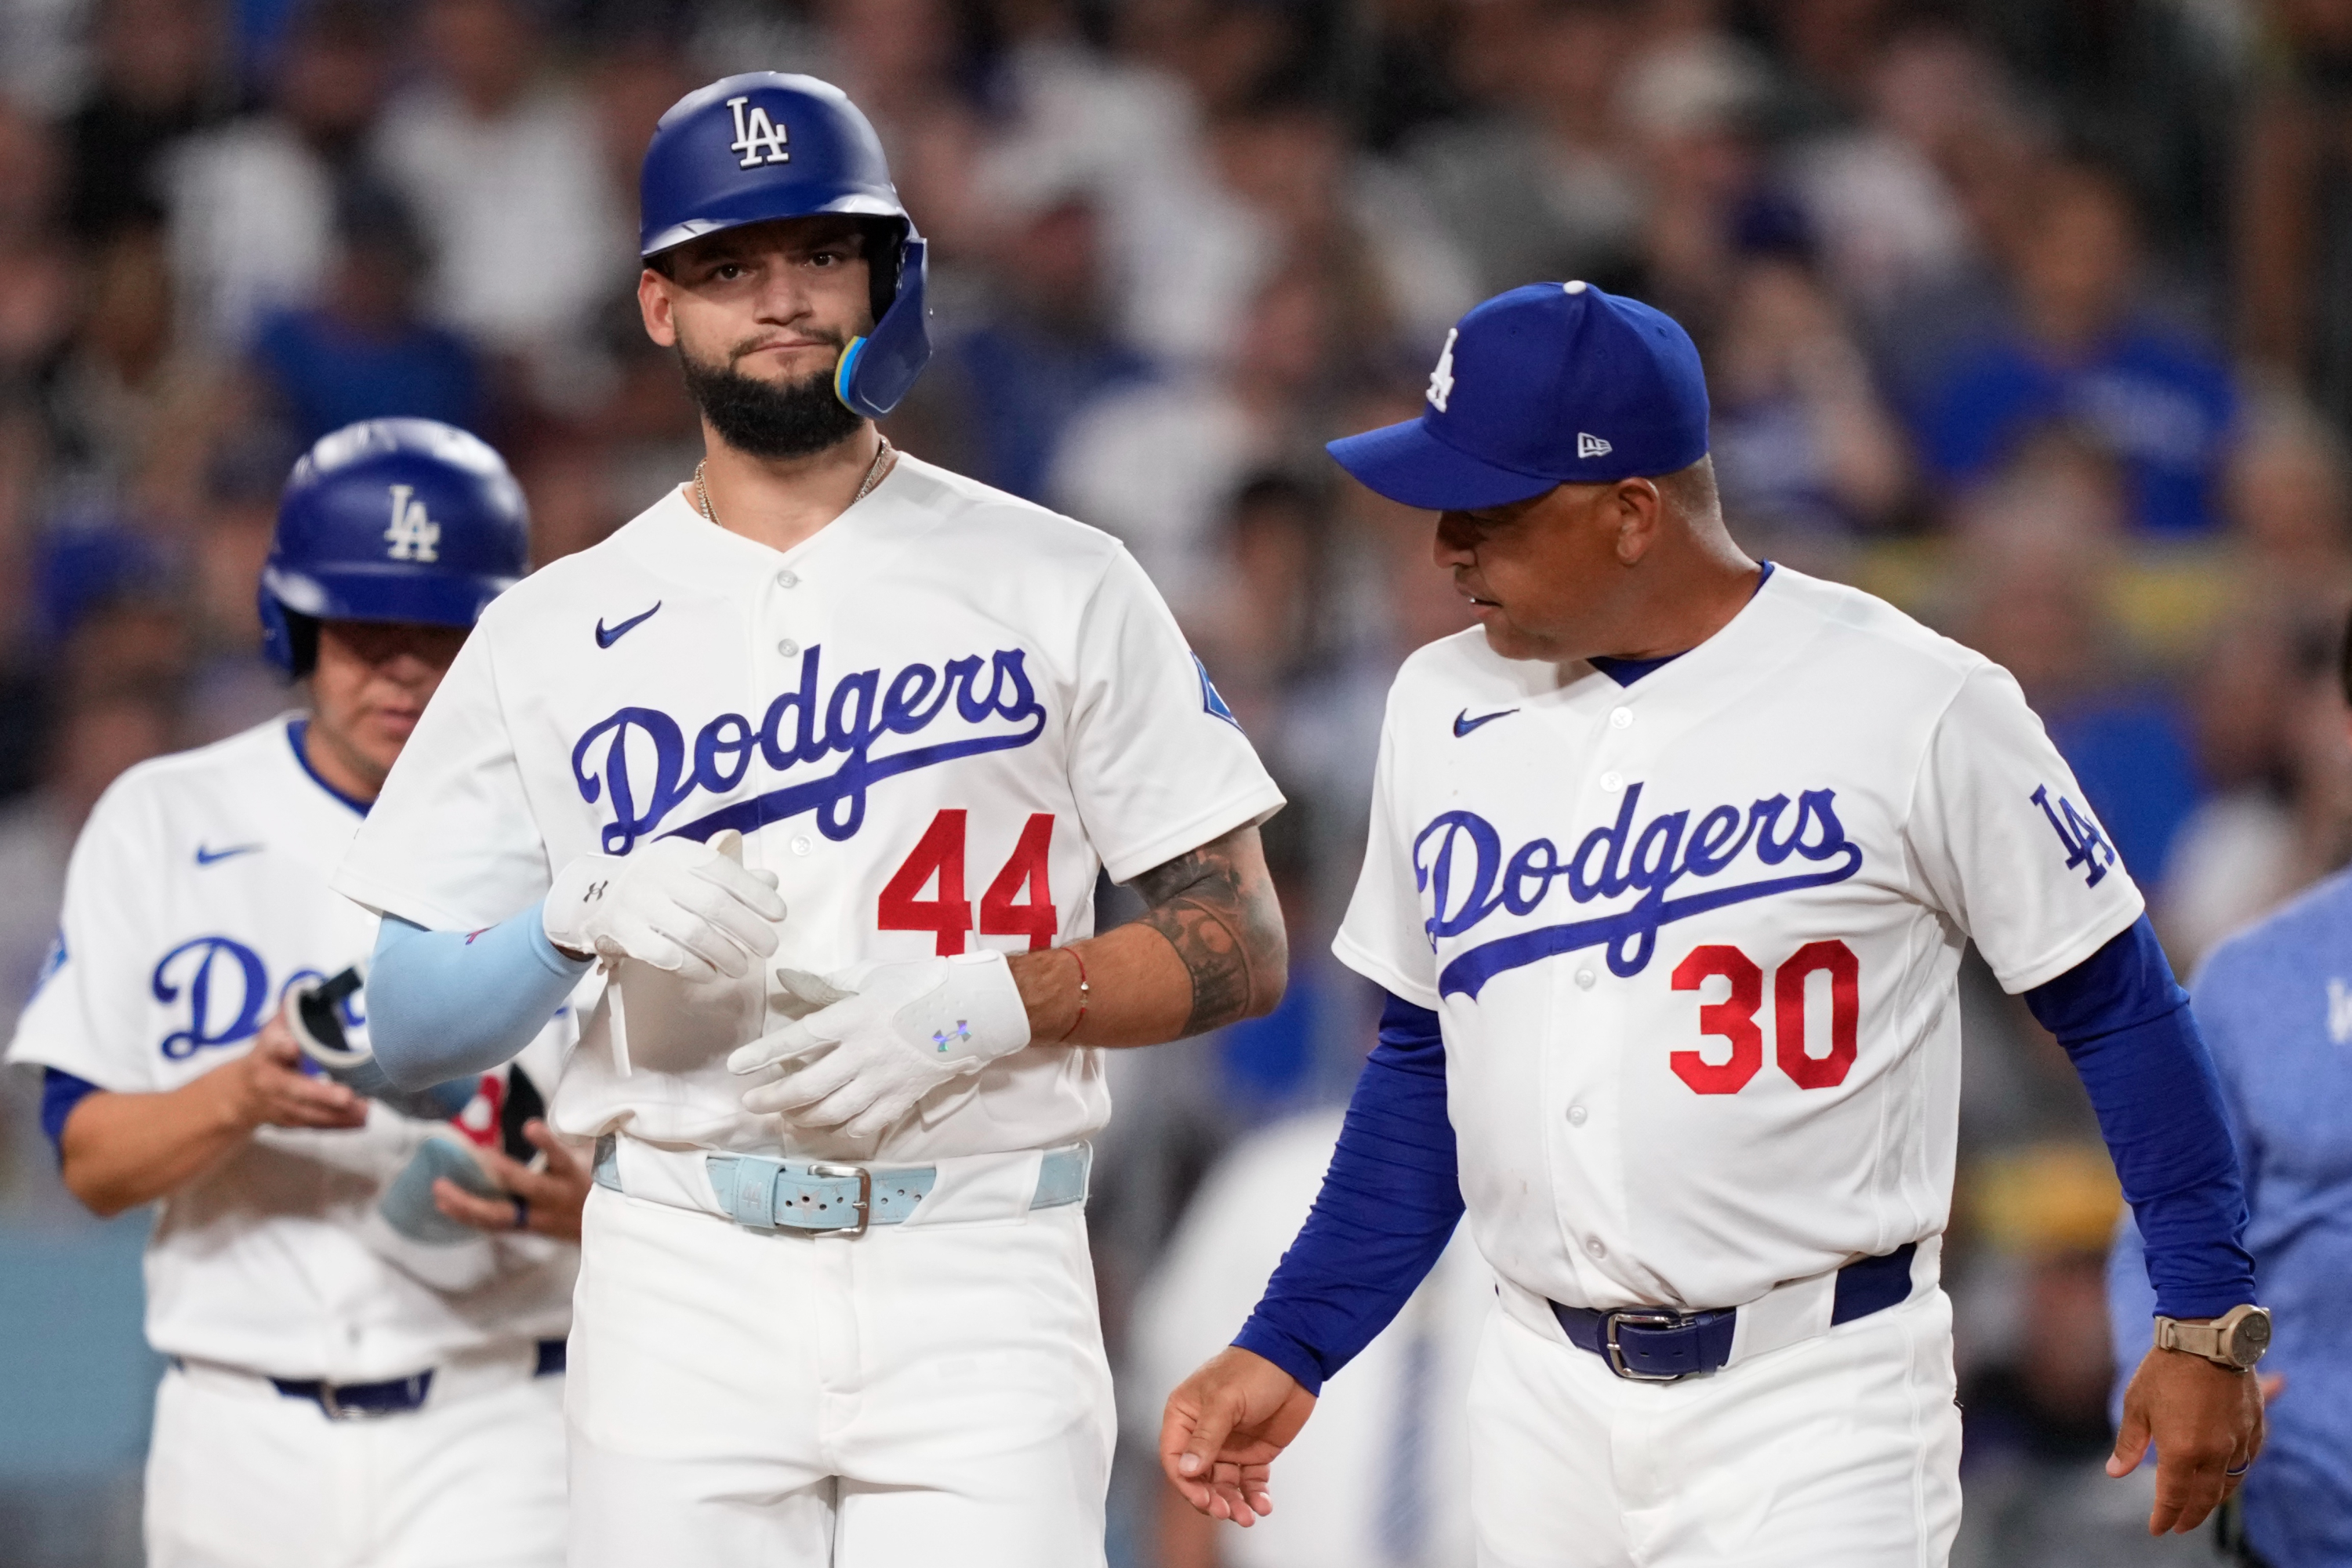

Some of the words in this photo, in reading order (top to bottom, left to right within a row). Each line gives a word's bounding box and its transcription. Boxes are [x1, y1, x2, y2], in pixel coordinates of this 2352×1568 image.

[727, 96, 789, 168] LA
[384, 484, 441, 562] LA
[572, 644, 1047, 855] Dodgers
[877, 808, 1058, 957] 44
[1414, 782, 1863, 1003] Dodgers
[2029, 783, 2115, 889] LA
[1669, 938, 1860, 1096] 30
